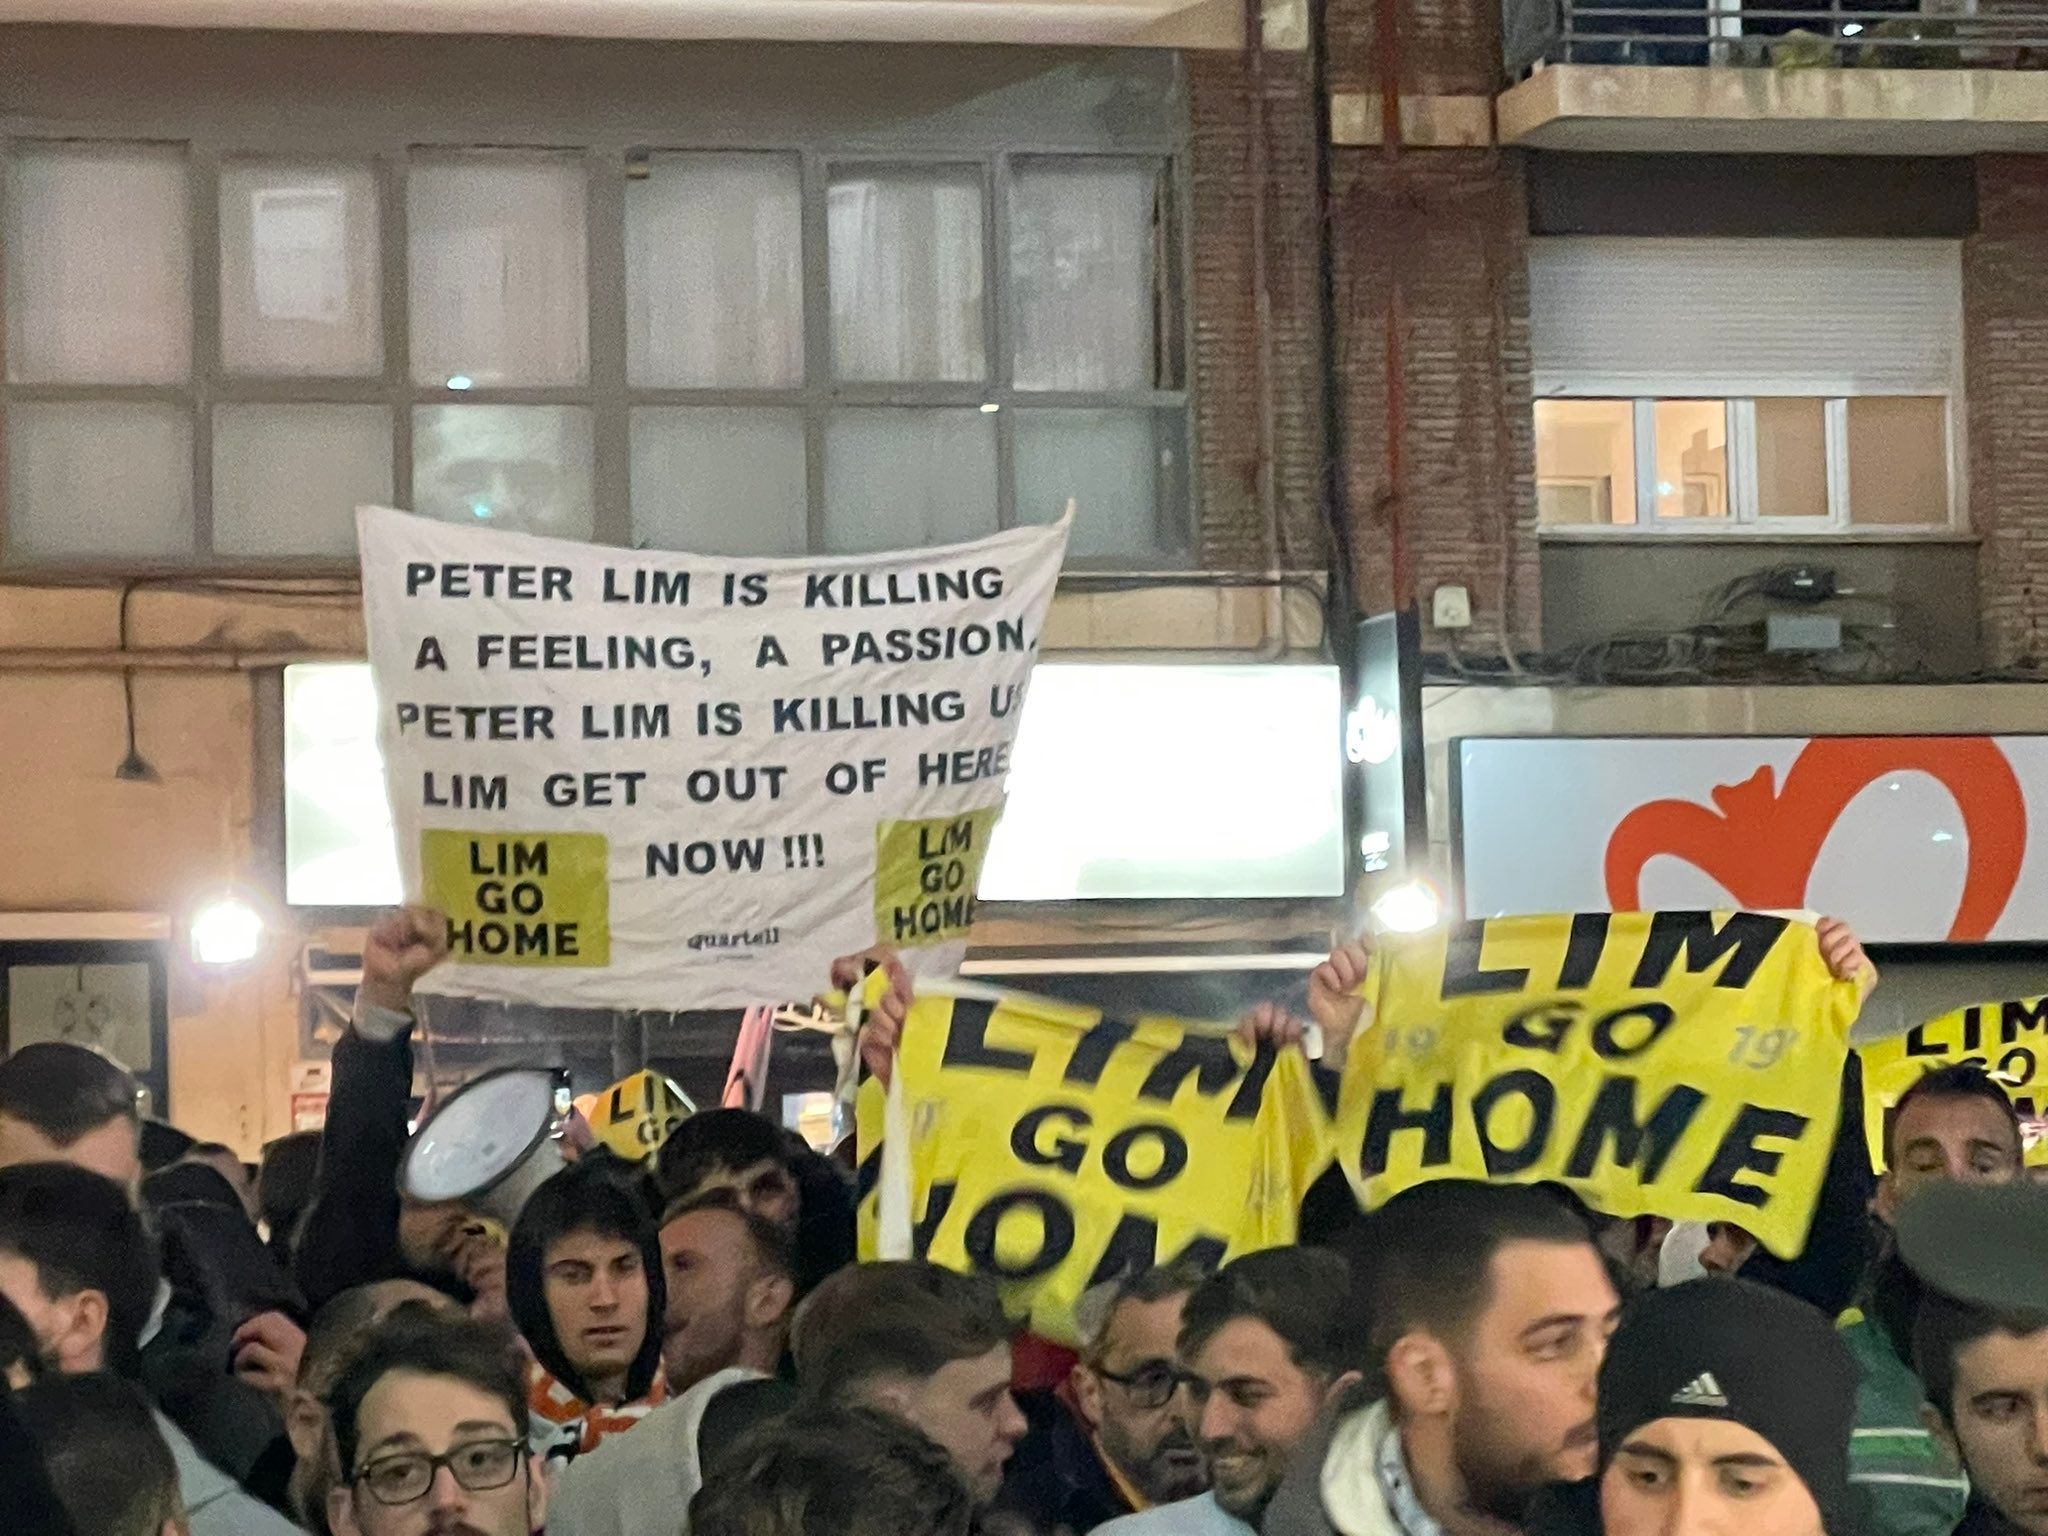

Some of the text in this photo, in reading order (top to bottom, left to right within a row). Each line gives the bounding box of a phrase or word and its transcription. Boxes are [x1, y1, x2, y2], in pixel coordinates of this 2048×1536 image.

[405, 562, 1004, 608] PETER LIM IS KILLING
[414, 635, 446, 672] A
[477, 634, 712, 678] FEELING,
[755, 635, 789, 669] A
[396, 701, 555, 740] PETER
[581, 704, 669, 739] LIM
[697, 701, 743, 736] IS
[773, 690, 966, 733] KILLING
[423, 772, 507, 811] LIM
[543, 771, 647, 807] GET
[686, 765, 788, 804] OUT
[825, 758, 887, 796] OF
[470, 841, 549, 876] LIM
[646, 838, 765, 878] NOW
[918, 820, 973, 860] LIM
[476, 881, 544, 916] GO
[921, 858, 964, 894] GO
[446, 918, 579, 957] HOME
[1440, 910, 1791, 1000] LIM
[1502, 1001, 1675, 1058] GO
[1010, 1104, 1188, 1191] GO
[1361, 1069, 1810, 1208] HOME
